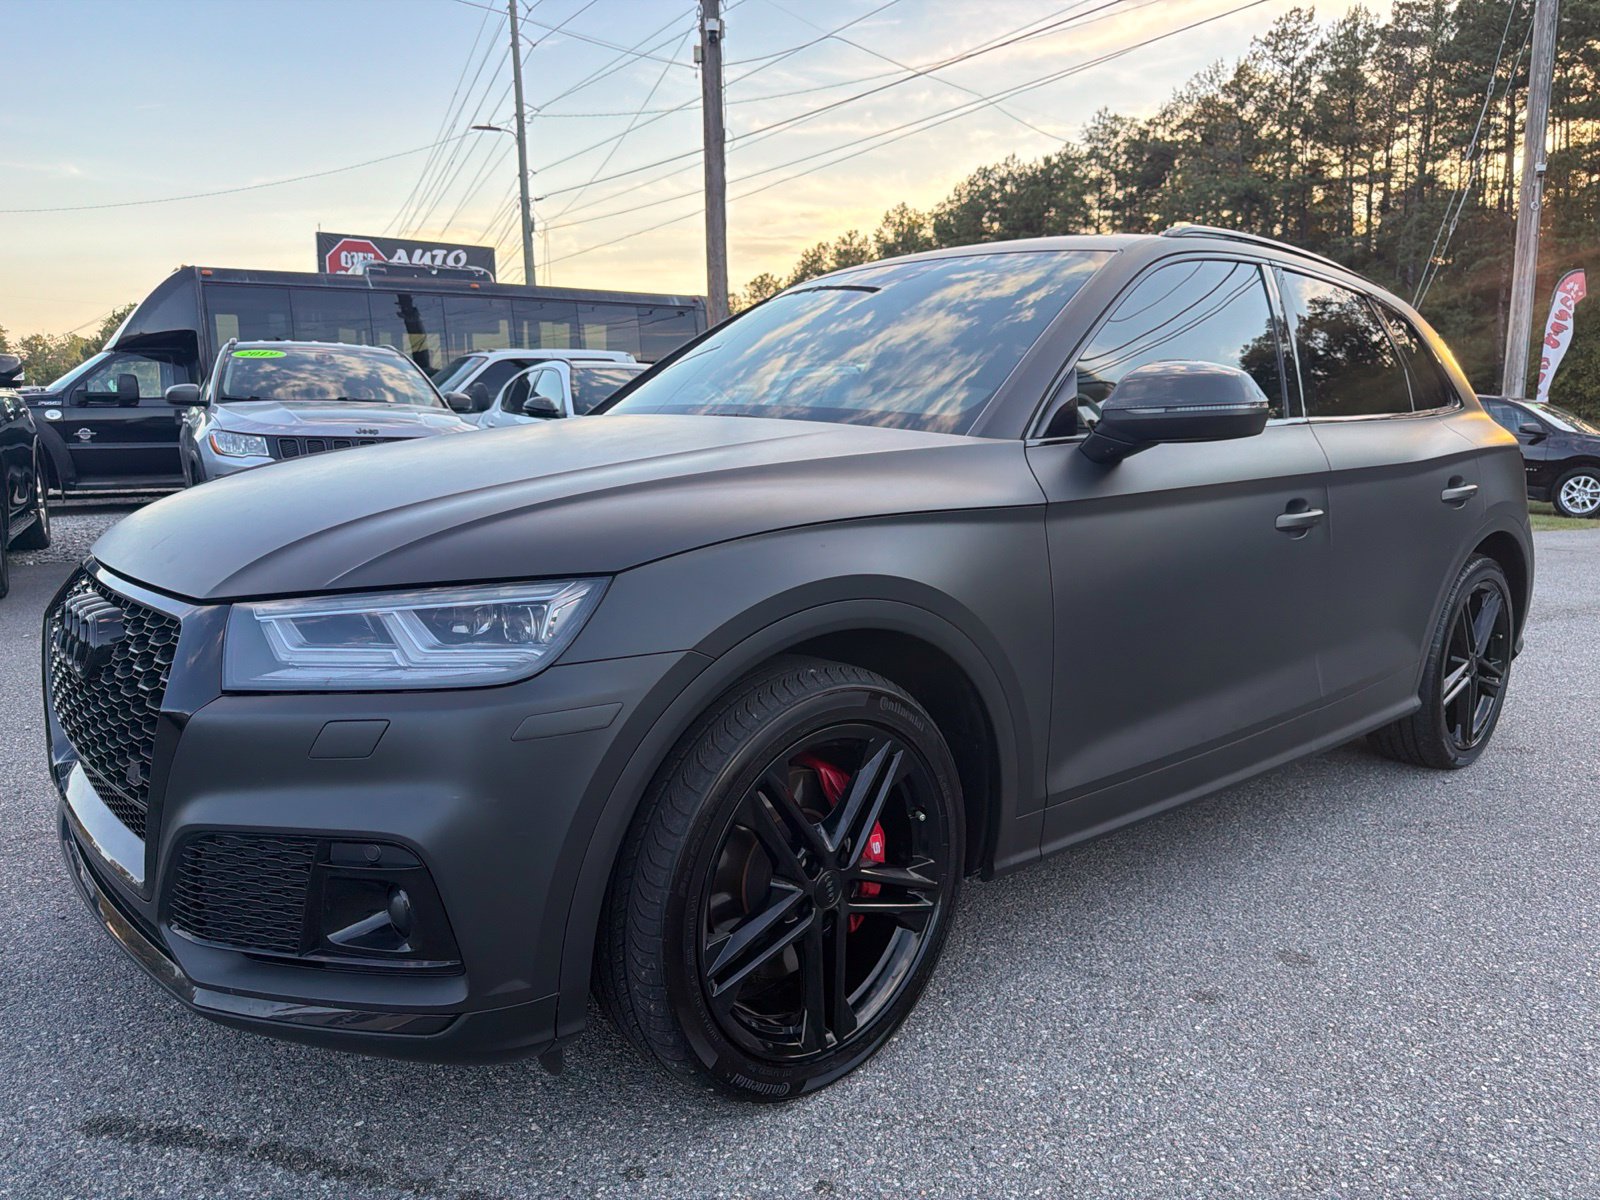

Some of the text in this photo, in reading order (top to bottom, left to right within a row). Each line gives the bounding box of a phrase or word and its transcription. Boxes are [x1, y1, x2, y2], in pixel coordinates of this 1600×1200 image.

[388, 248, 467, 267] AUTO
[355, 427, 379, 436] Jeep
[879, 695, 925, 732] Continental
[729, 1072, 791, 1097] Continental
